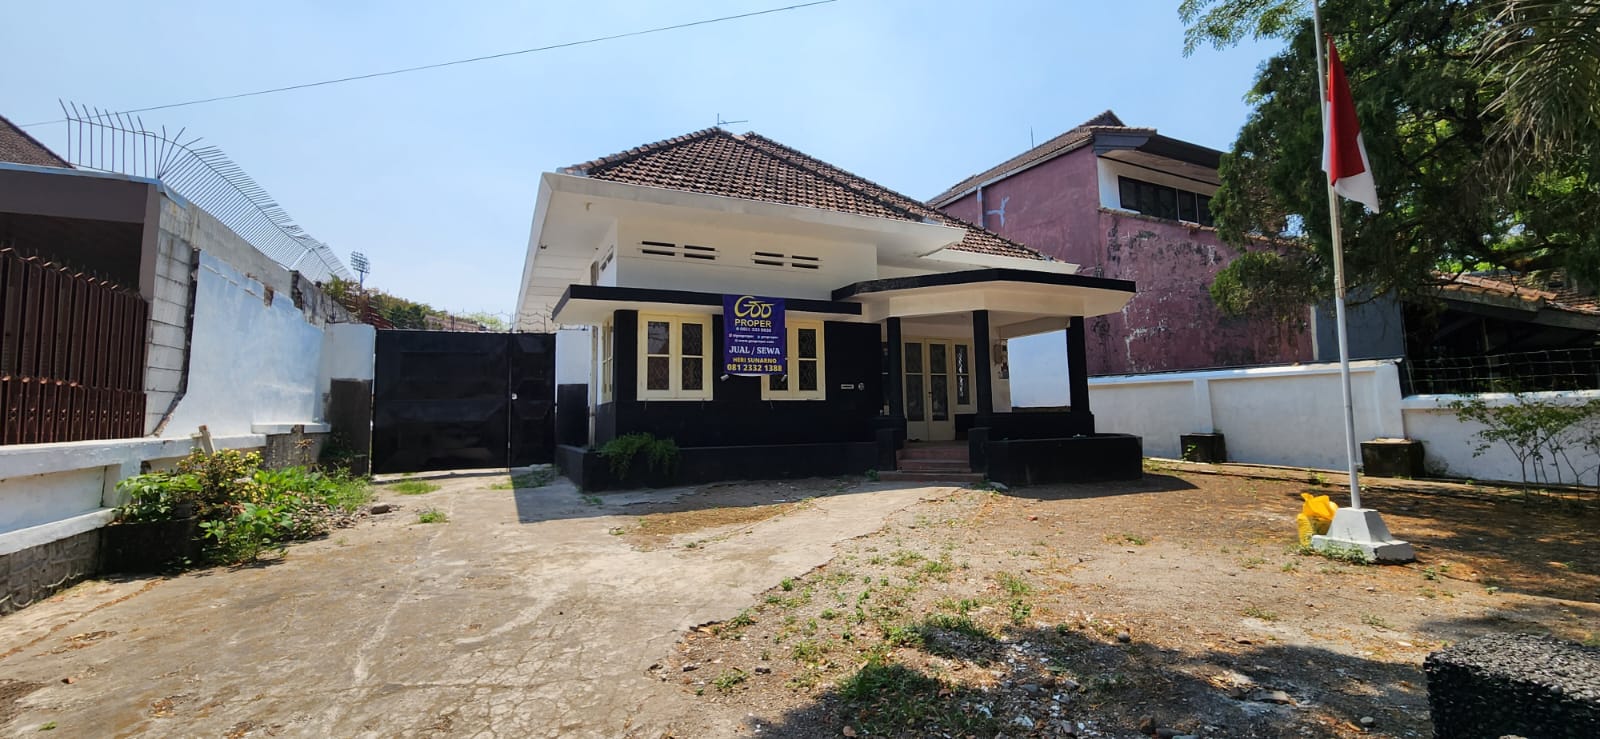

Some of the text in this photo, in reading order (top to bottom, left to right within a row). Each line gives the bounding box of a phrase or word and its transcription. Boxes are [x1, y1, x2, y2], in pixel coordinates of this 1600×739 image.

[734, 318, 772, 327] PROPER
[729, 345, 750, 353] JUAL
[756, 347, 781, 355] SEWA
[727, 363, 741, 371] 081
